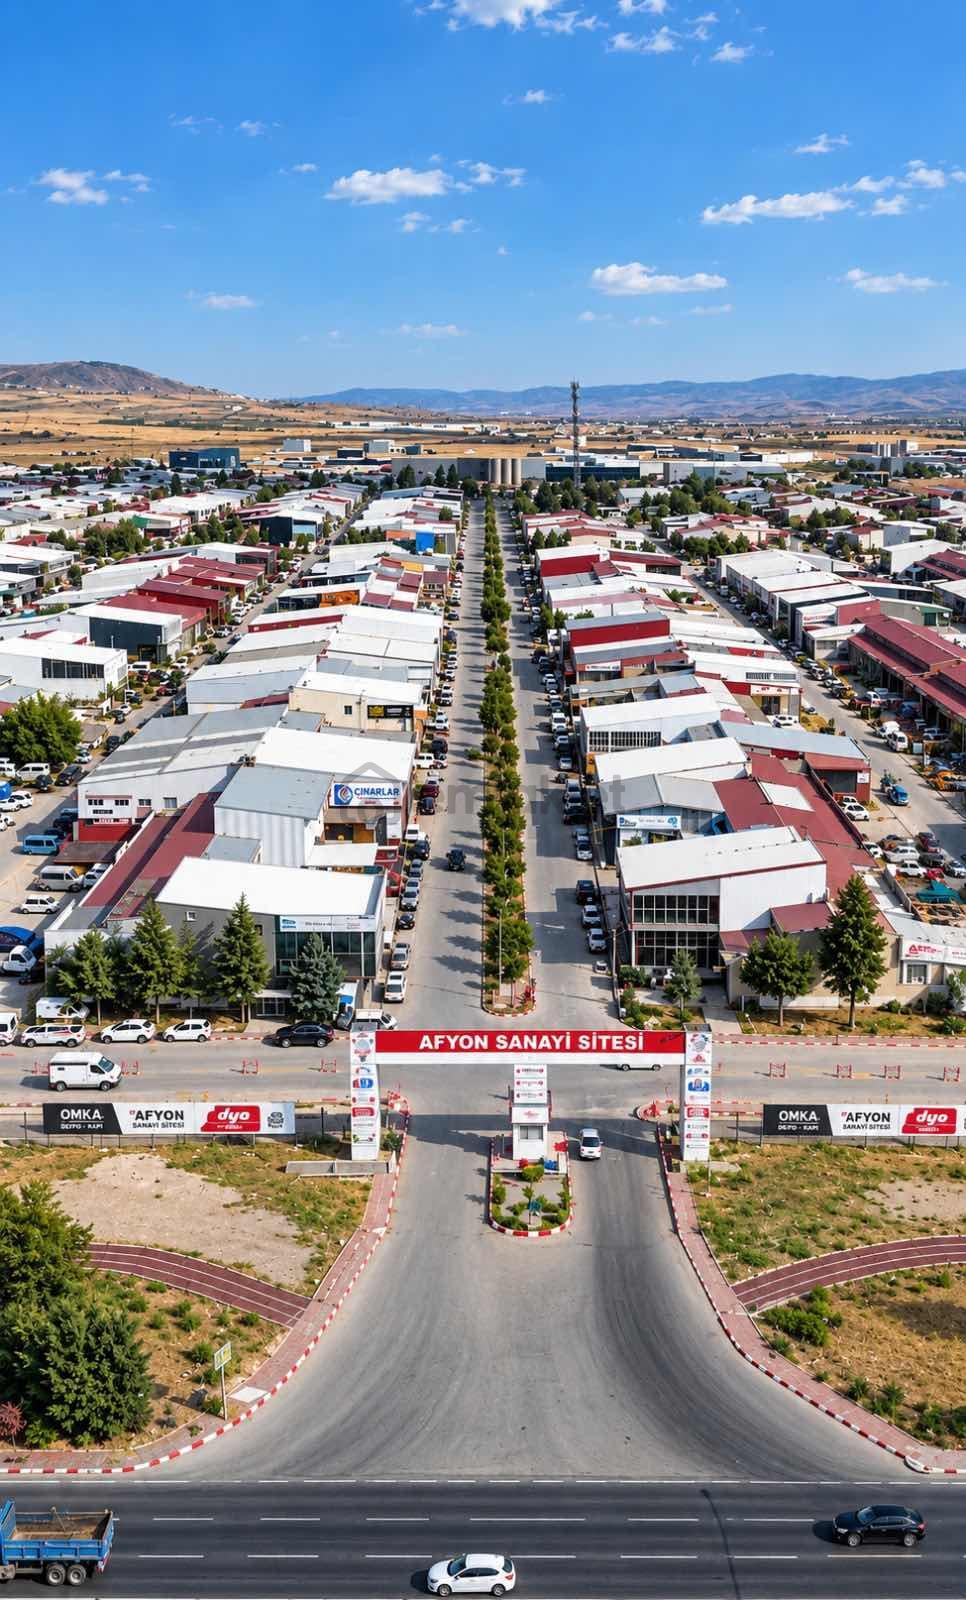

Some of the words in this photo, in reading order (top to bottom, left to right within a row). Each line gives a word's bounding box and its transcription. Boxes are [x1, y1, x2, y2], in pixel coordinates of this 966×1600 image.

[419, 1034, 489, 1050] AFYON
[495, 1031, 571, 1050] SANAYİ
[578, 1031, 644, 1050] SİTESİ
[60, 1109, 102, 1121] OMKA
[135, 1110, 185, 1121] AFYON
[217, 1107, 251, 1124] dyo
[779, 1110, 818, 1121] OMKA
[845, 1111, 891, 1122] AFYON
[916, 1110, 949, 1125] dyo
